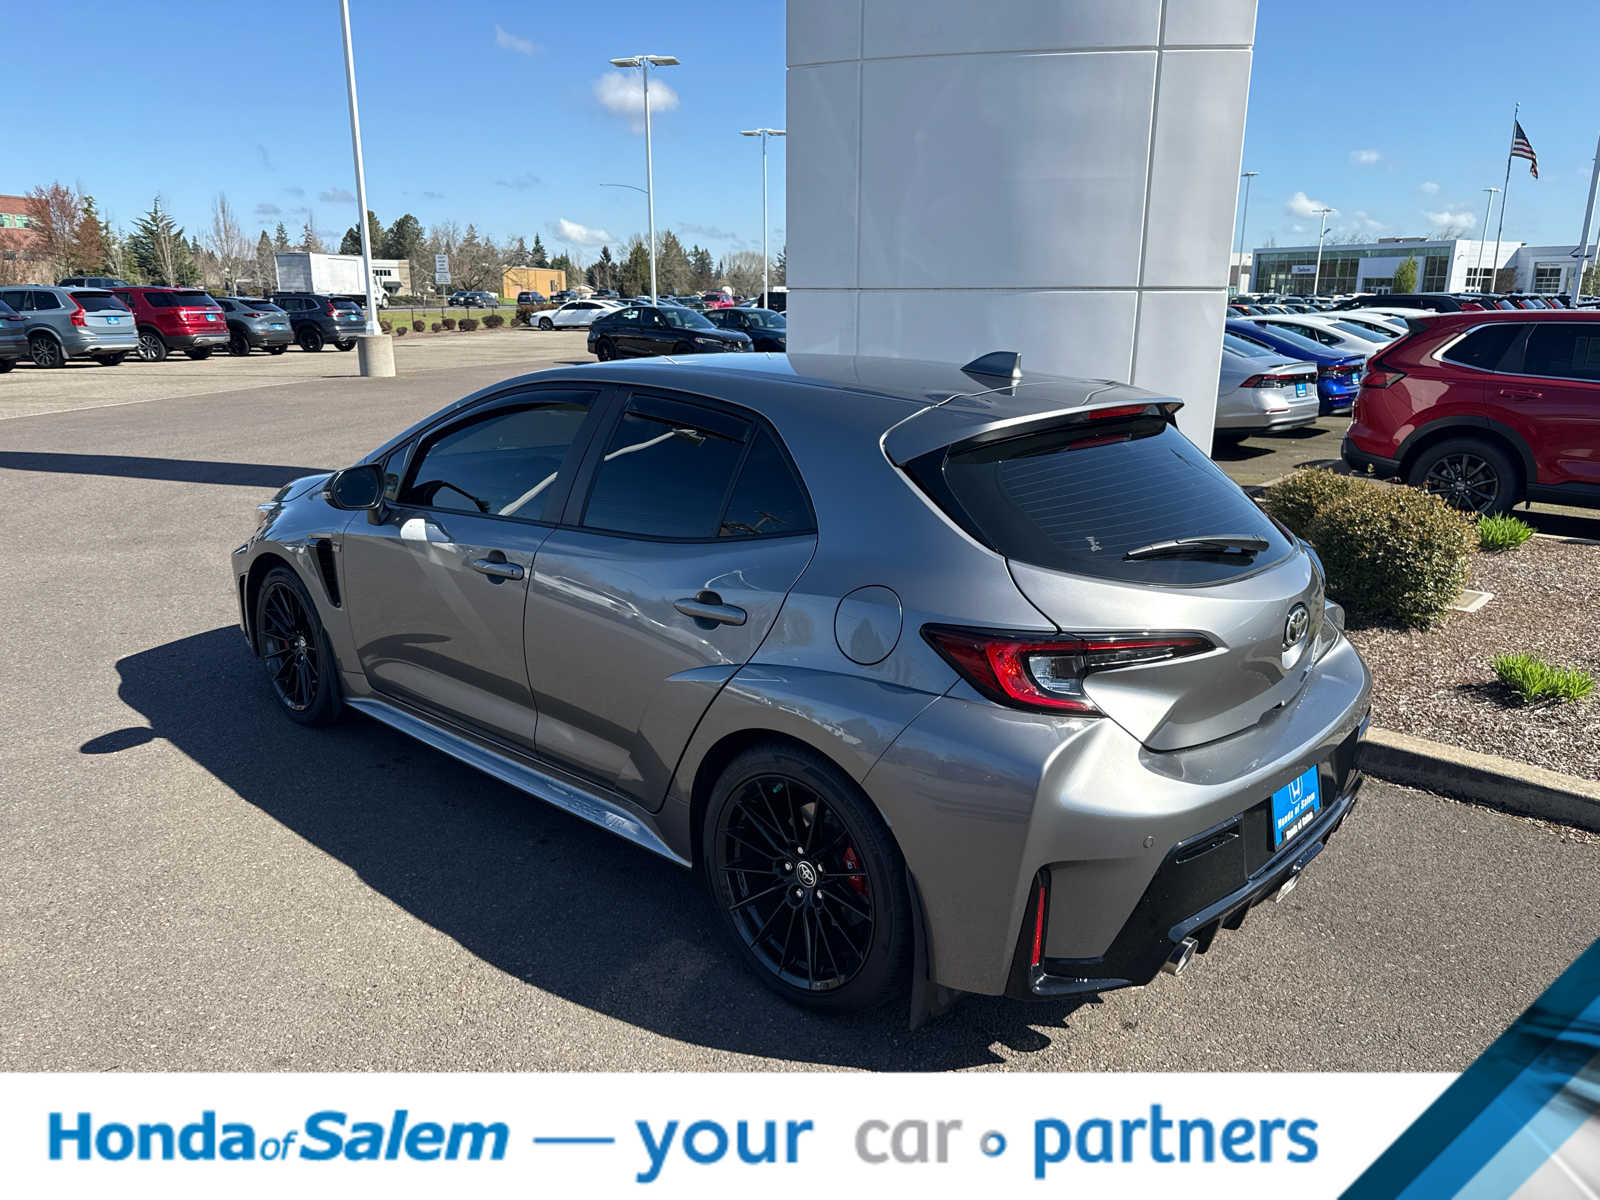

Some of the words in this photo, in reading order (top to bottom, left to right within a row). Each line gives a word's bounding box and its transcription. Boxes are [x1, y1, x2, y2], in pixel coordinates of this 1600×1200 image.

[1278, 810, 1293, 829] Honda
[1294, 803, 1300, 815] of
[1301, 792, 1315, 810] Salem
